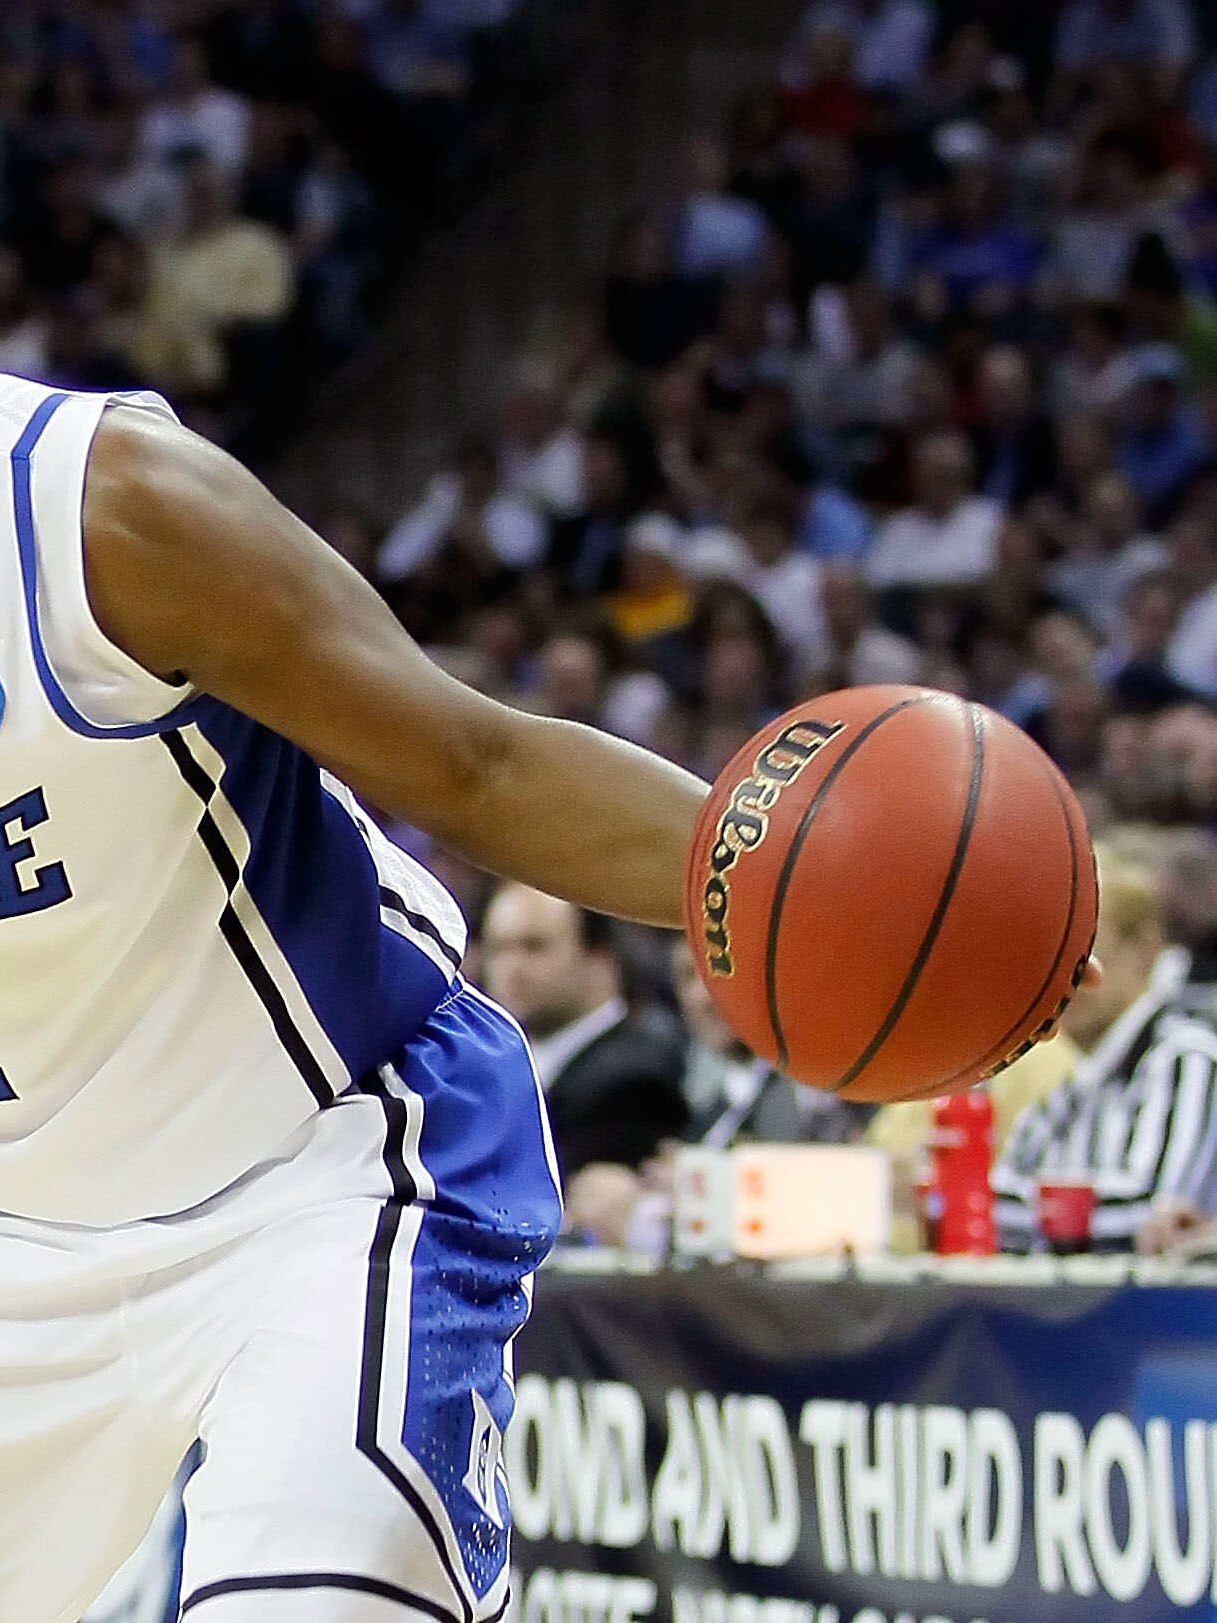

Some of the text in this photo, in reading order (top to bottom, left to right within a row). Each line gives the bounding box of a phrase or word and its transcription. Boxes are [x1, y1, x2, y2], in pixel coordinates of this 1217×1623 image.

[704, 719, 848, 977] Wilson
[652, 1388, 800, 1567] AND
[800, 1398, 1024, 1588] THIRD
[1033, 1410, 1217, 1607] ROU
